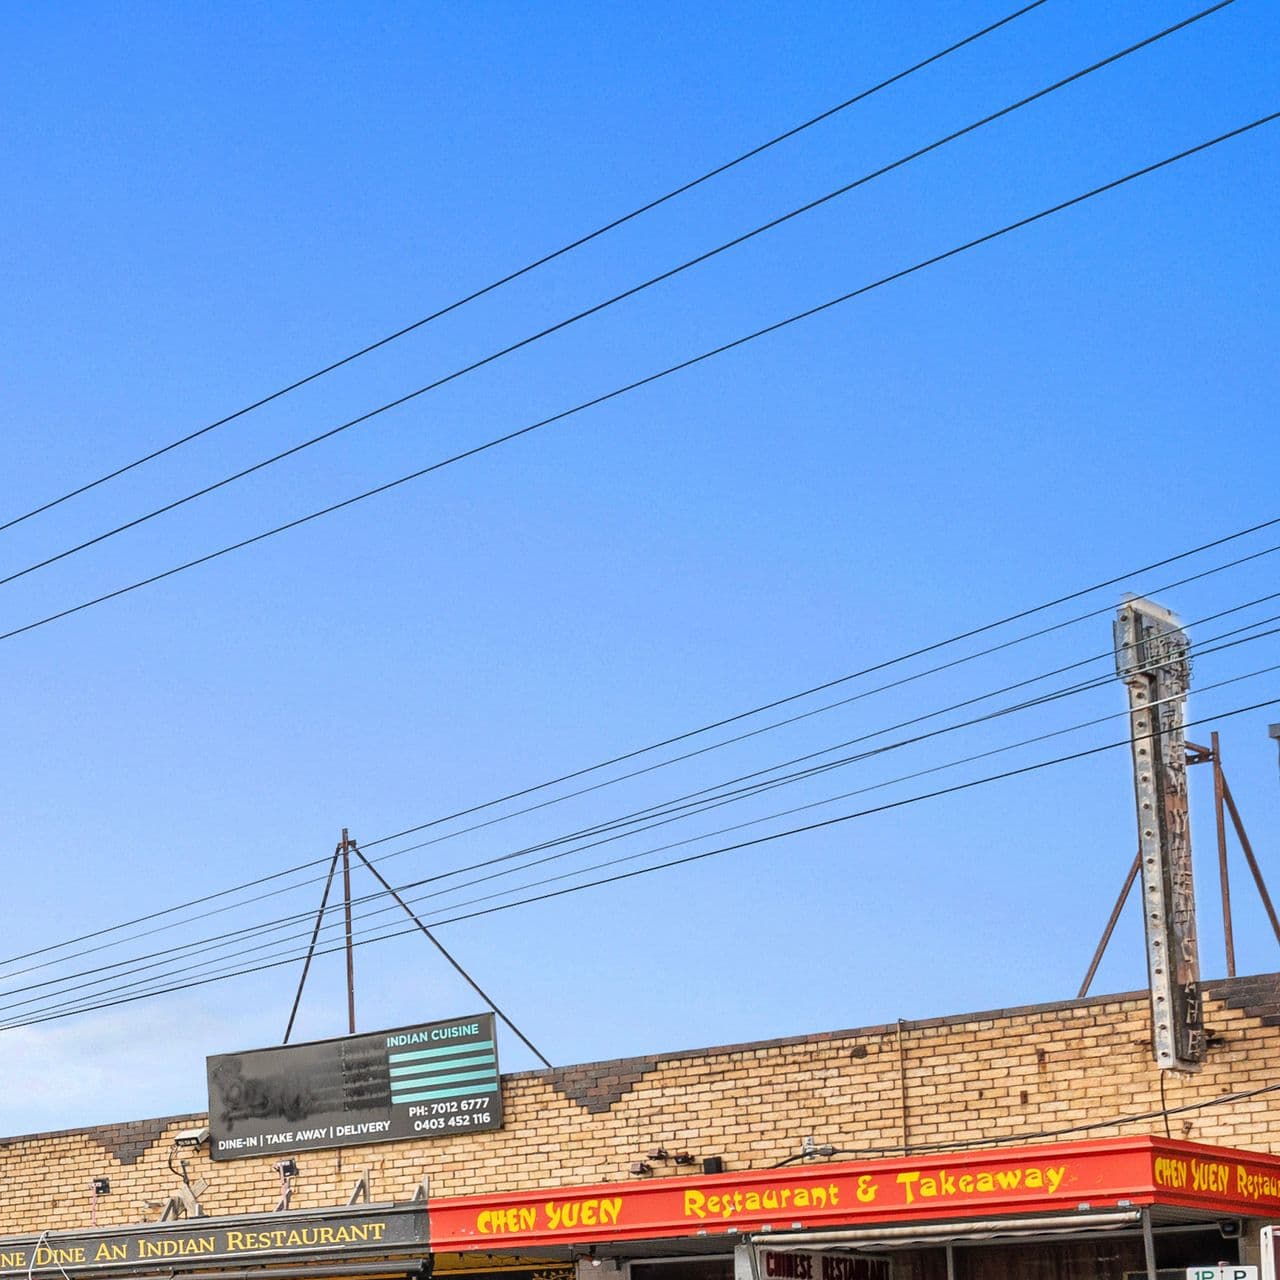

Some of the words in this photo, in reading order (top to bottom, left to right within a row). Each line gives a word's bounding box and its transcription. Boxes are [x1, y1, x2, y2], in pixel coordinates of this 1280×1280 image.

[386, 1031, 428, 1048] INDIAN
[431, 1023, 480, 1041] CUISINE
[408, 1105, 428, 1117] PH:
[430, 1102, 458, 1115] 7012
[460, 1097, 490, 1111] 6777
[414, 1118, 445, 1132] 0403
[447, 1115, 470, 1128] 452
[473, 1112, 491, 1125] 116
[218, 1136, 258, 1151] DINE-IN
[265, 1132, 294, 1146] TAKE
[296, 1128, 328, 1142] AWAY
[336, 1120, 391, 1137] DELIVERY
[1154, 1156, 1187, 1189] CHEN
[1190, 1157, 1230, 1195] YUEN
[476, 1206, 536, 1235] CHEN
[544, 1197, 623, 1230] YUEN
[684, 1183, 840, 1219] Restaurant
[856, 1174, 878, 1203] &
[896, 1166, 1067, 1205] Takeaway
[36, 1247, 86, 1266] DINE
[95, 1242, 128, 1261] AN
[138, 1236, 215, 1257] INDIAN
[226, 1222, 386, 1251] RESTAURANT
[766, 1251, 814, 1280] CHINESE
